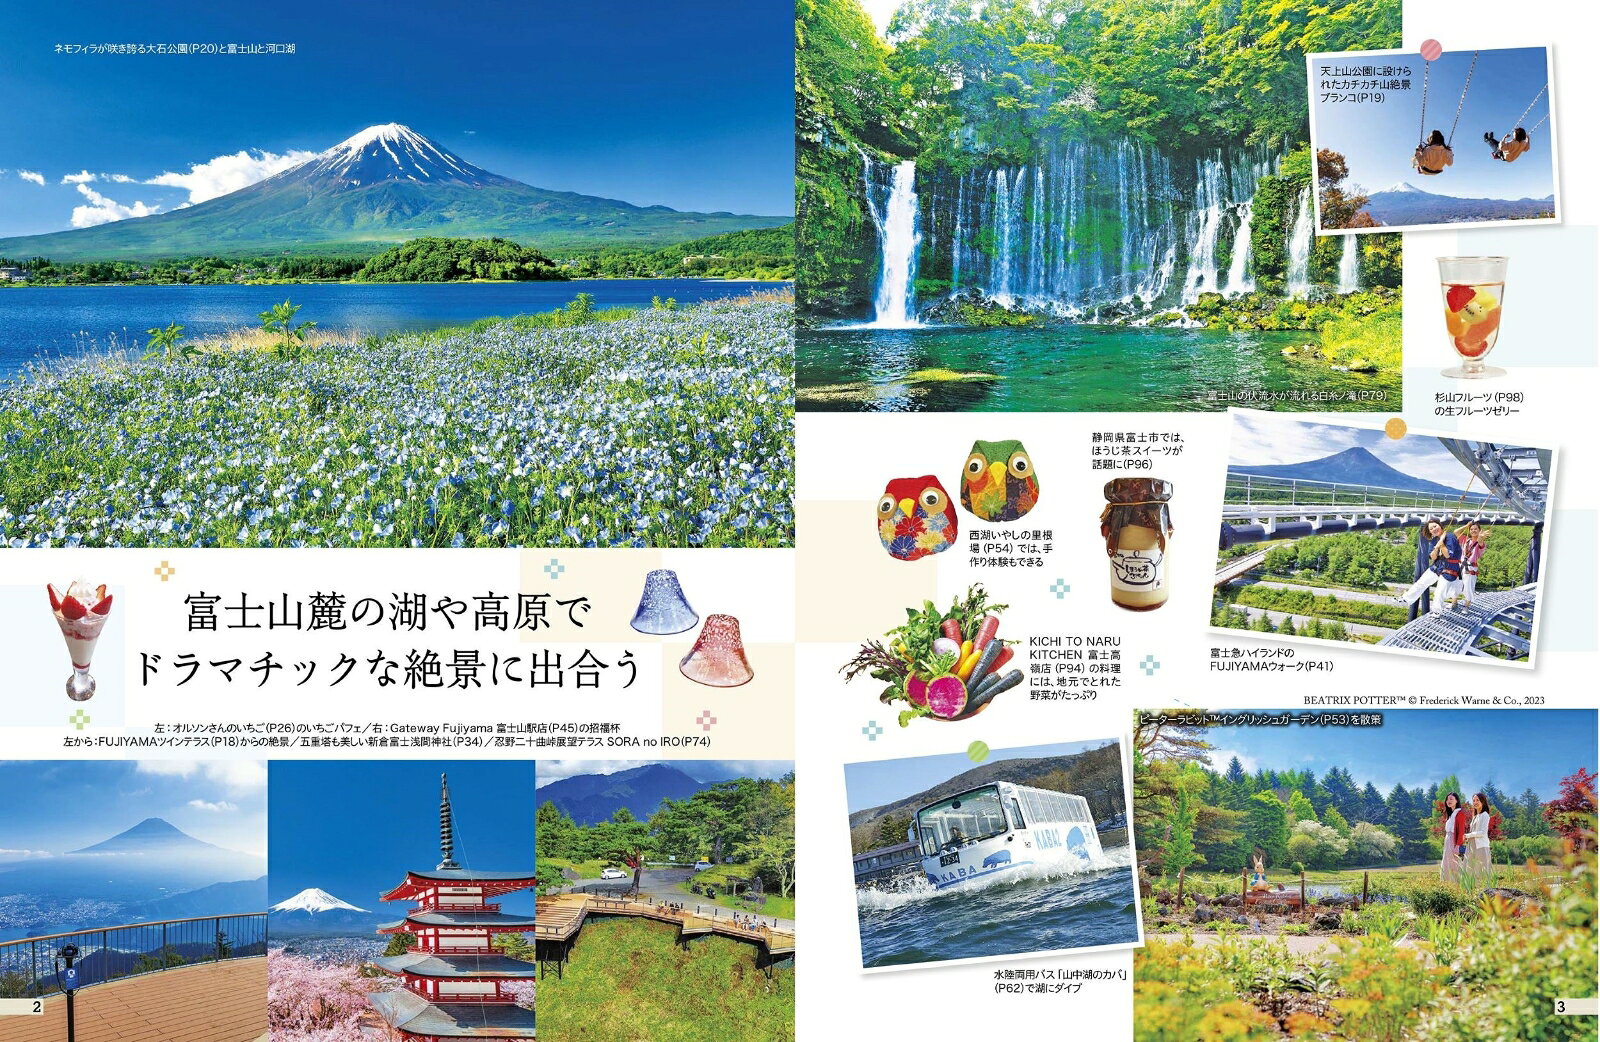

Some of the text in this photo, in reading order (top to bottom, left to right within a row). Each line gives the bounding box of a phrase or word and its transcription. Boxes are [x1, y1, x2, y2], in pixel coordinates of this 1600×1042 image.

[1434, 405, 1520, 417] の生フルーツゼリー
[1091, 431, 1185, 444] 静岡県富士市では、
[1091, 445, 1184, 457] ほうじ茶スイーツが
[1091, 458, 1153, 470] 話題に(P96)
[968, 529, 1053, 541] 西湖いやしの里根
[968, 556, 1044, 568] 作り体験もできる
[183, 590, 592, 632] 富士山麓の湖や高原で
[1029, 636, 1121, 647] KICHI TO NARU
[1029, 649, 1121, 661] KITCHEN 富士高
[1210, 647, 1295, 659] 富士急ハイランドの
[136, 648, 641, 690] ドラマチックな絶景に出合う
[1029, 676, 1122, 687] には、地元でとれた
[1029, 689, 1098, 701] 野菜がたっぷり
[1303, 695, 1350, 706] BEATRIX
[1420, 695, 1459, 706] Frederick
[1461, 695, 1490, 706] Warne
[1492, 695, 1502, 706] &
[1503, 695, 1521, 707] Co.,
[1524, 695, 1545, 706] 2023
[442, 722, 494, 735] Fujiyama
[607, 735, 640, 747] SORA
[643, 737, 657, 747] no
[940, 864, 977, 883] KABA
[994, 982, 1083, 994] (P62)で湖にダイブ
[32, 1000, 42, 1013] 2
[1557, 1000, 1566, 1013] 3
